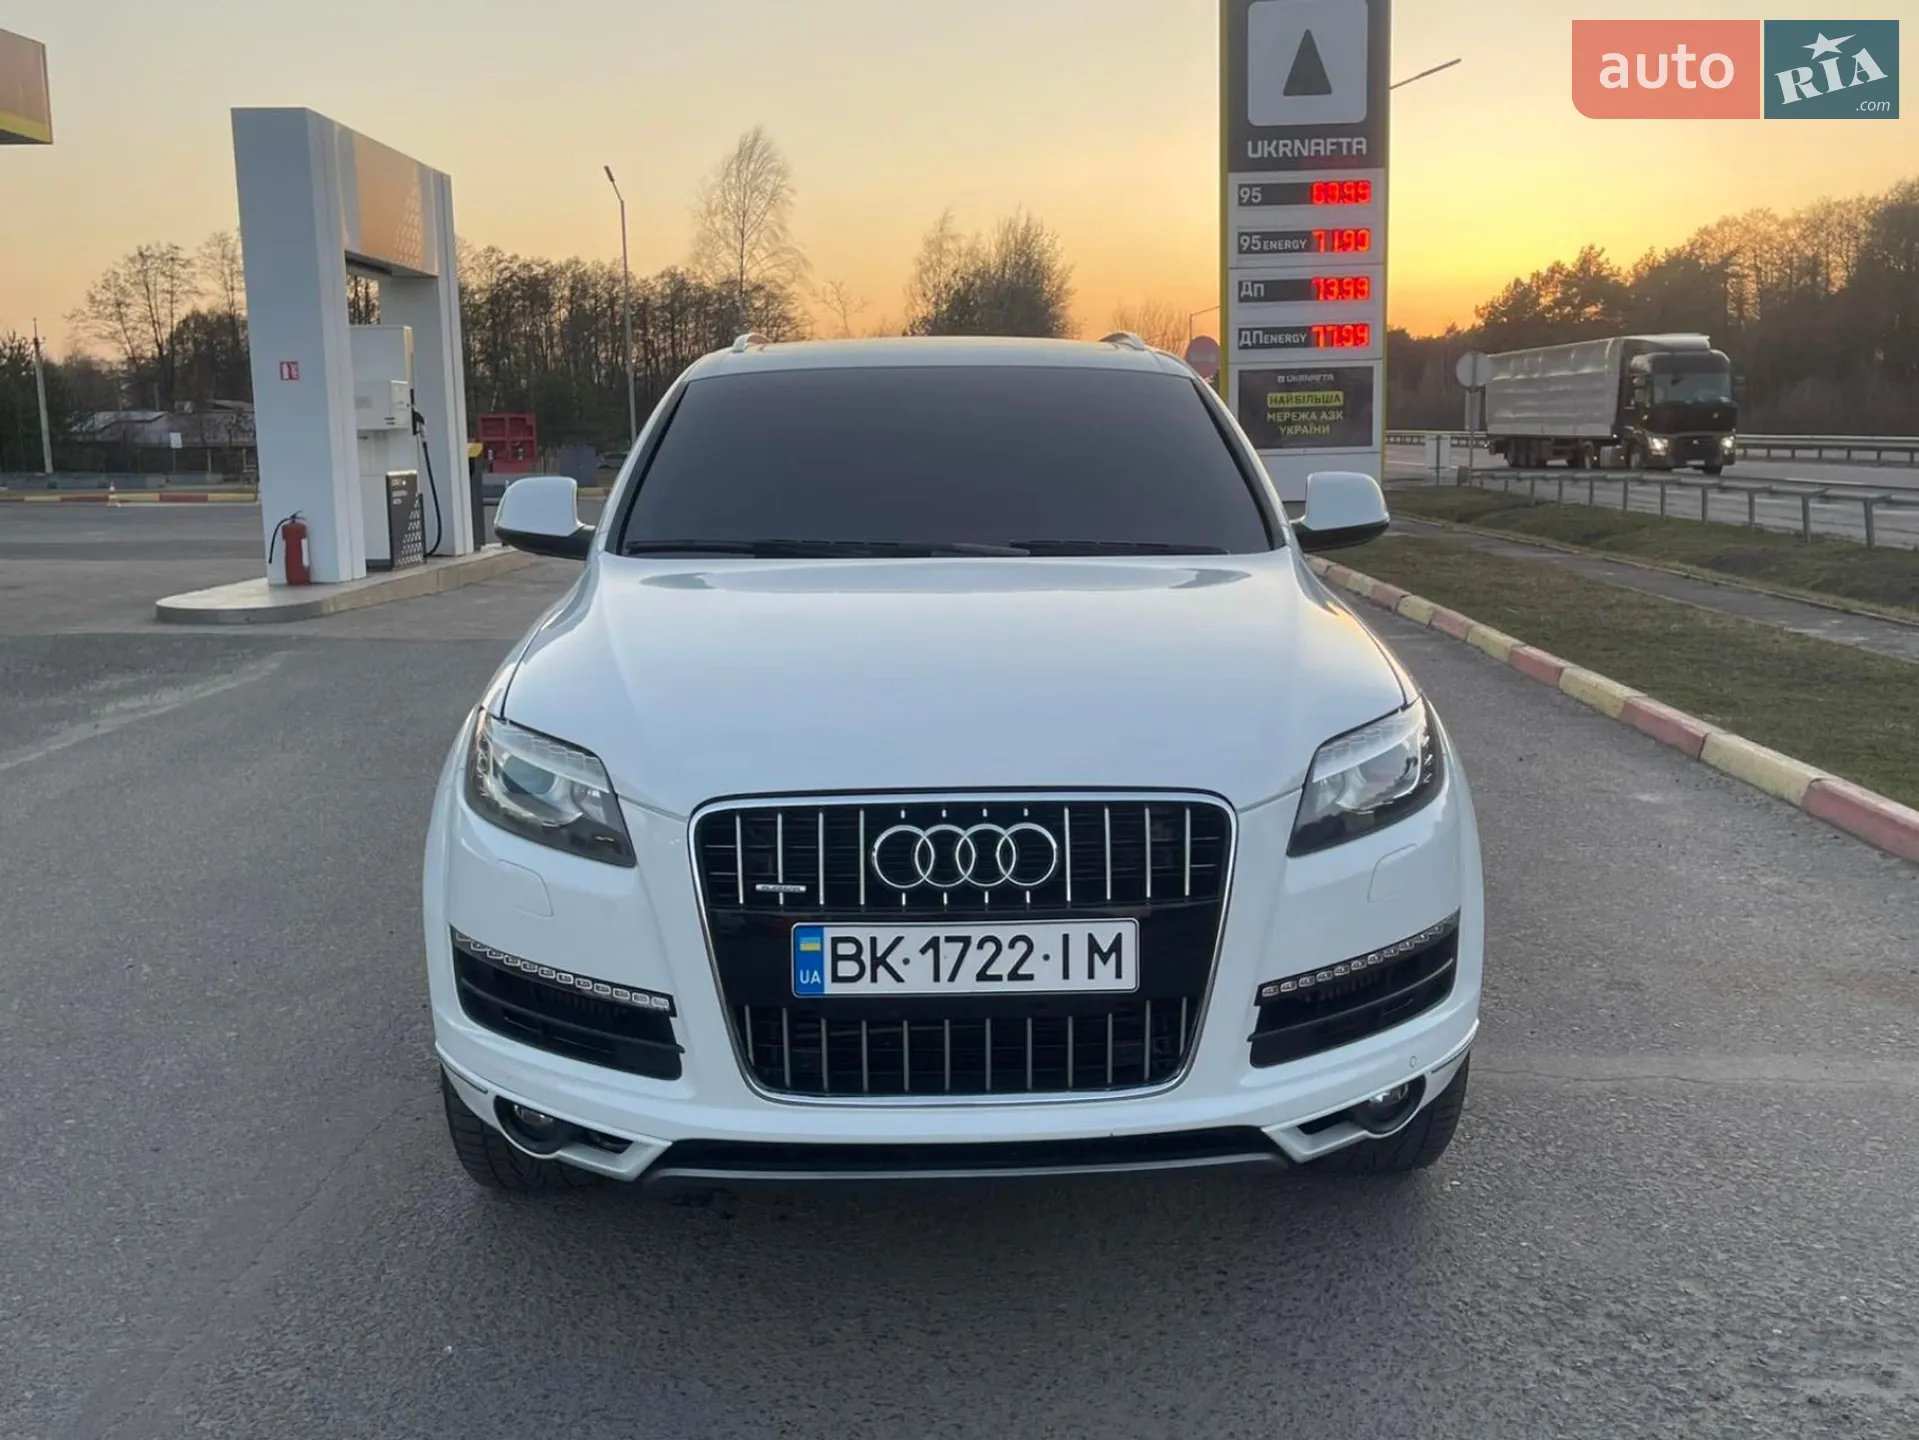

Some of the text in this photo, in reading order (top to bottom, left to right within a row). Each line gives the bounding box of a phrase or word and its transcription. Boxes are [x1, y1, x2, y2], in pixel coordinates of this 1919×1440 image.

[1247, 137, 1367, 158] UKRNAFTA
[1240, 187, 1262, 203] 95
[1240, 235, 1262, 251] 95
[1263, 239, 1307, 251] ENERGY
[1264, 333, 1307, 345] ENERGY
[1266, 411, 1318, 422] МЕРЕЖА
[800, 970, 822, 985] UA
